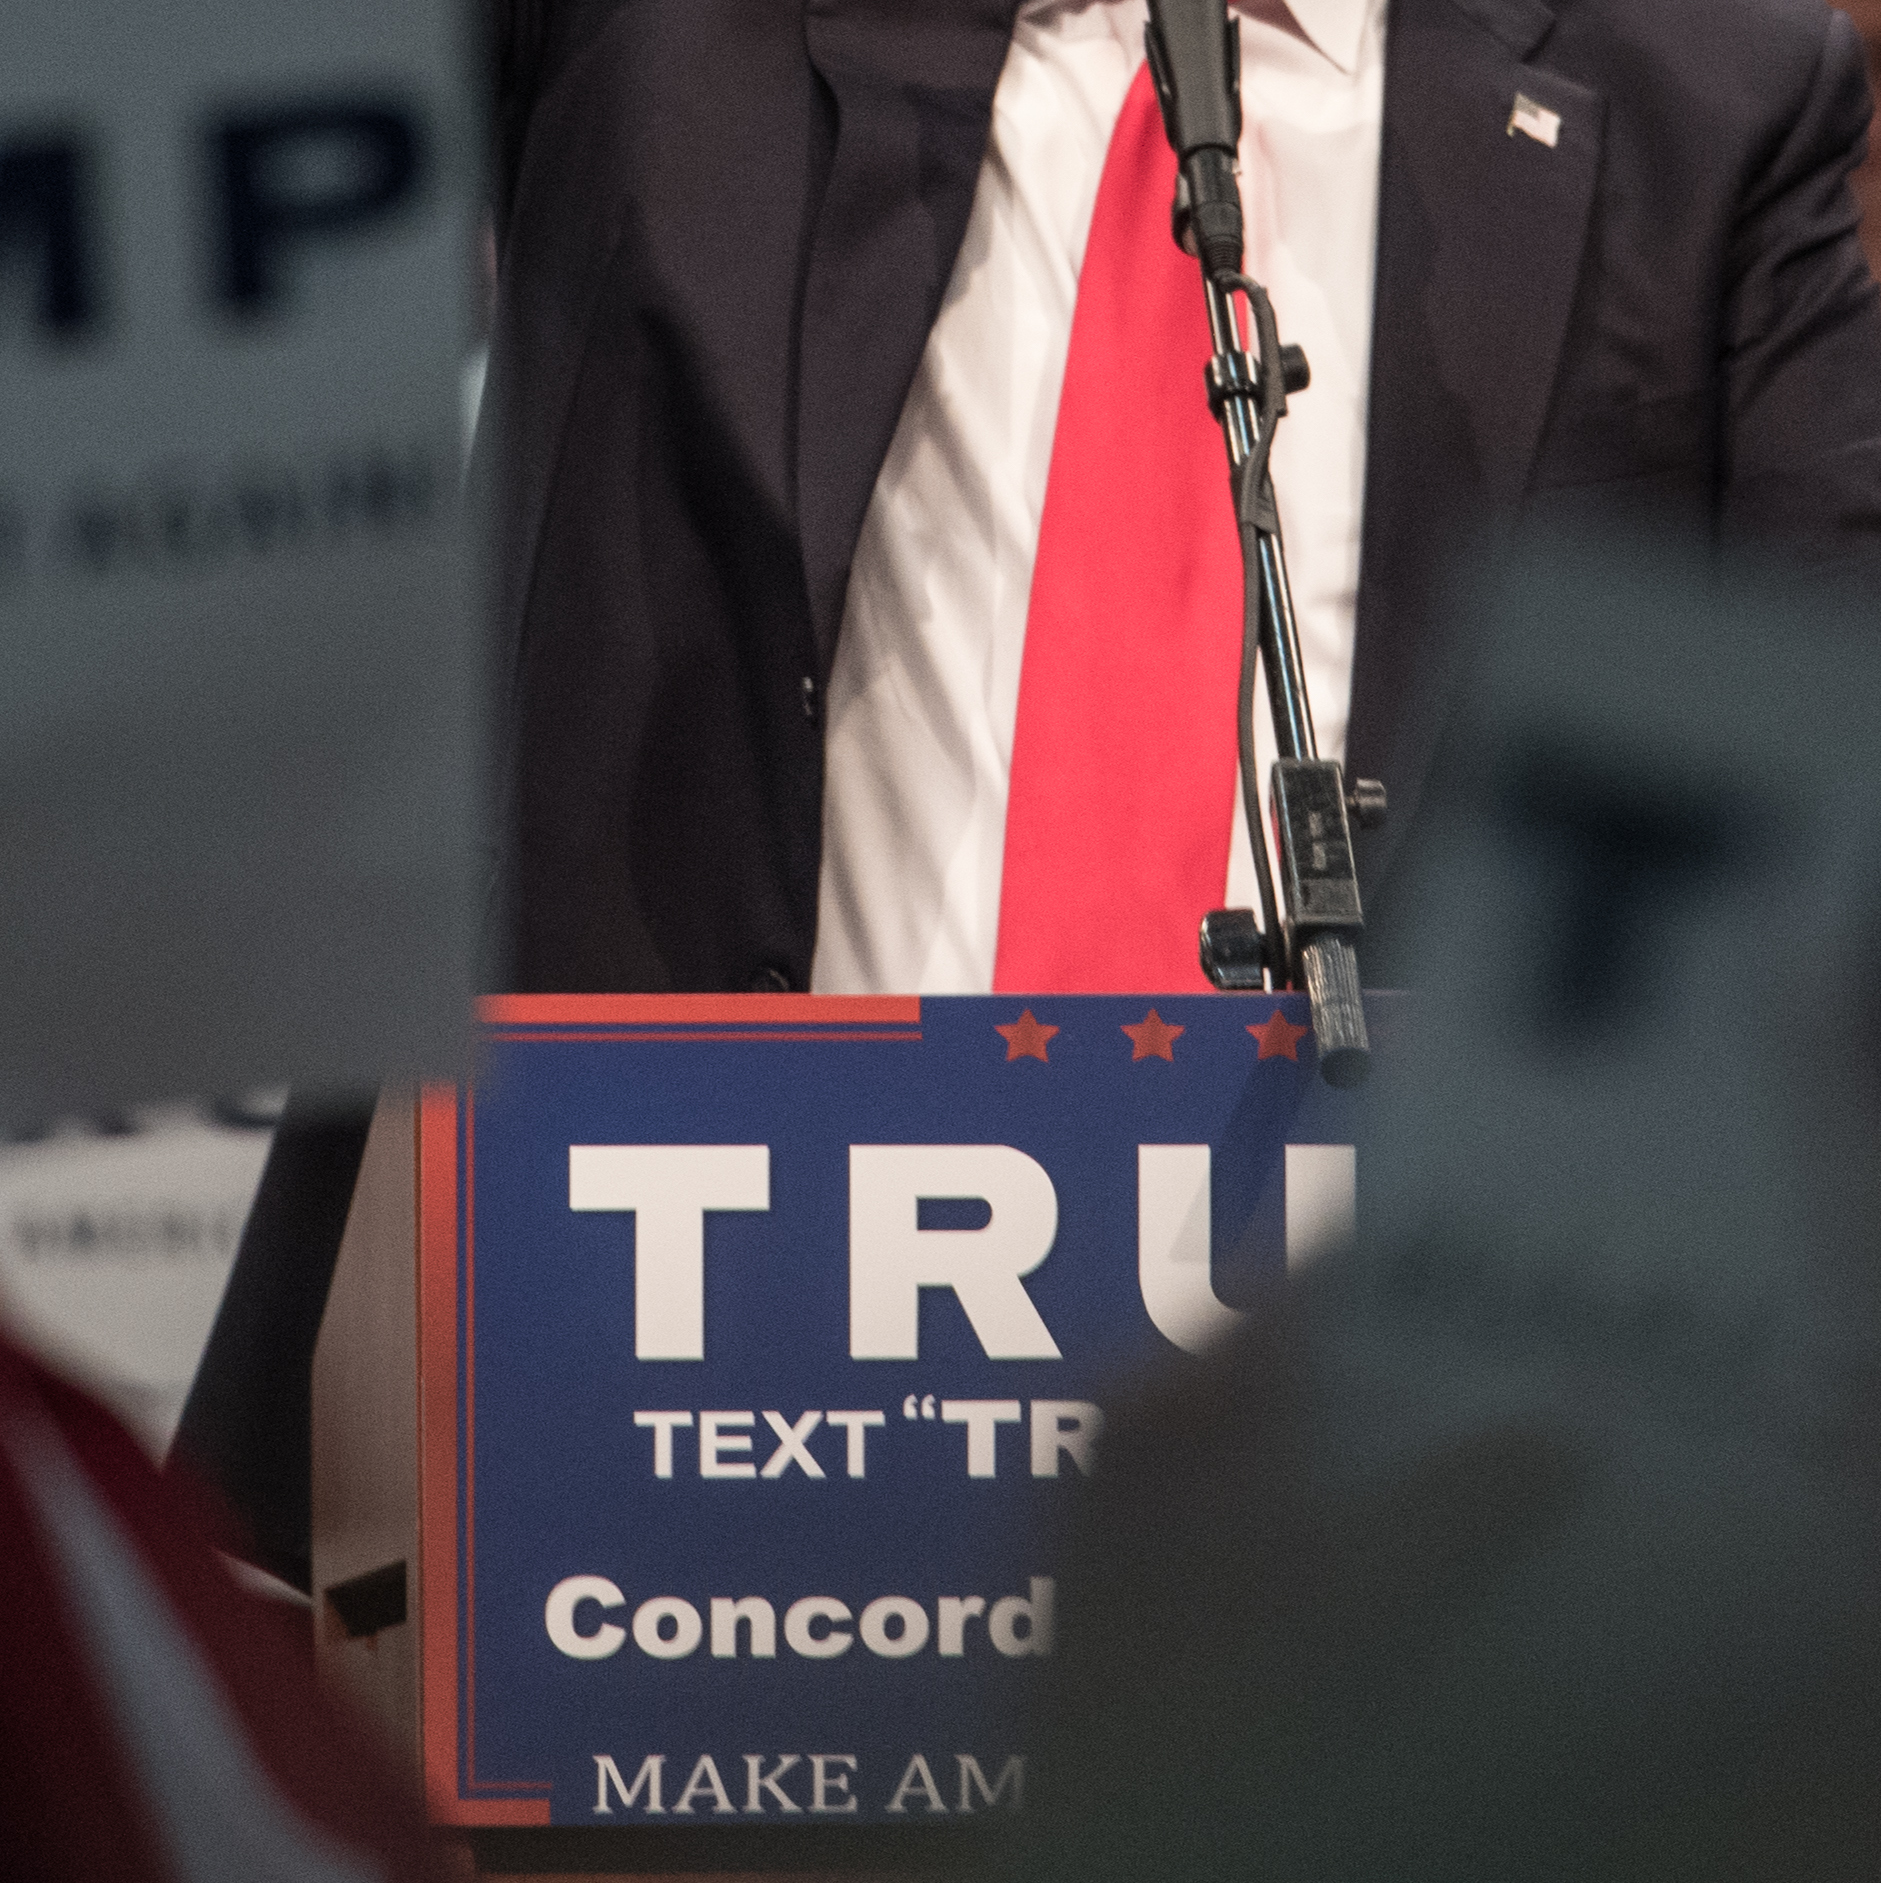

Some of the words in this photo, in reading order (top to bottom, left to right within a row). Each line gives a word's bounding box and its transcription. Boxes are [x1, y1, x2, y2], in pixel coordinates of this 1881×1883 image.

[632, 1409, 886, 1480] TEXT
[543, 1574, 1058, 1660] Concord
[590, 1753, 860, 1815] MAKE
